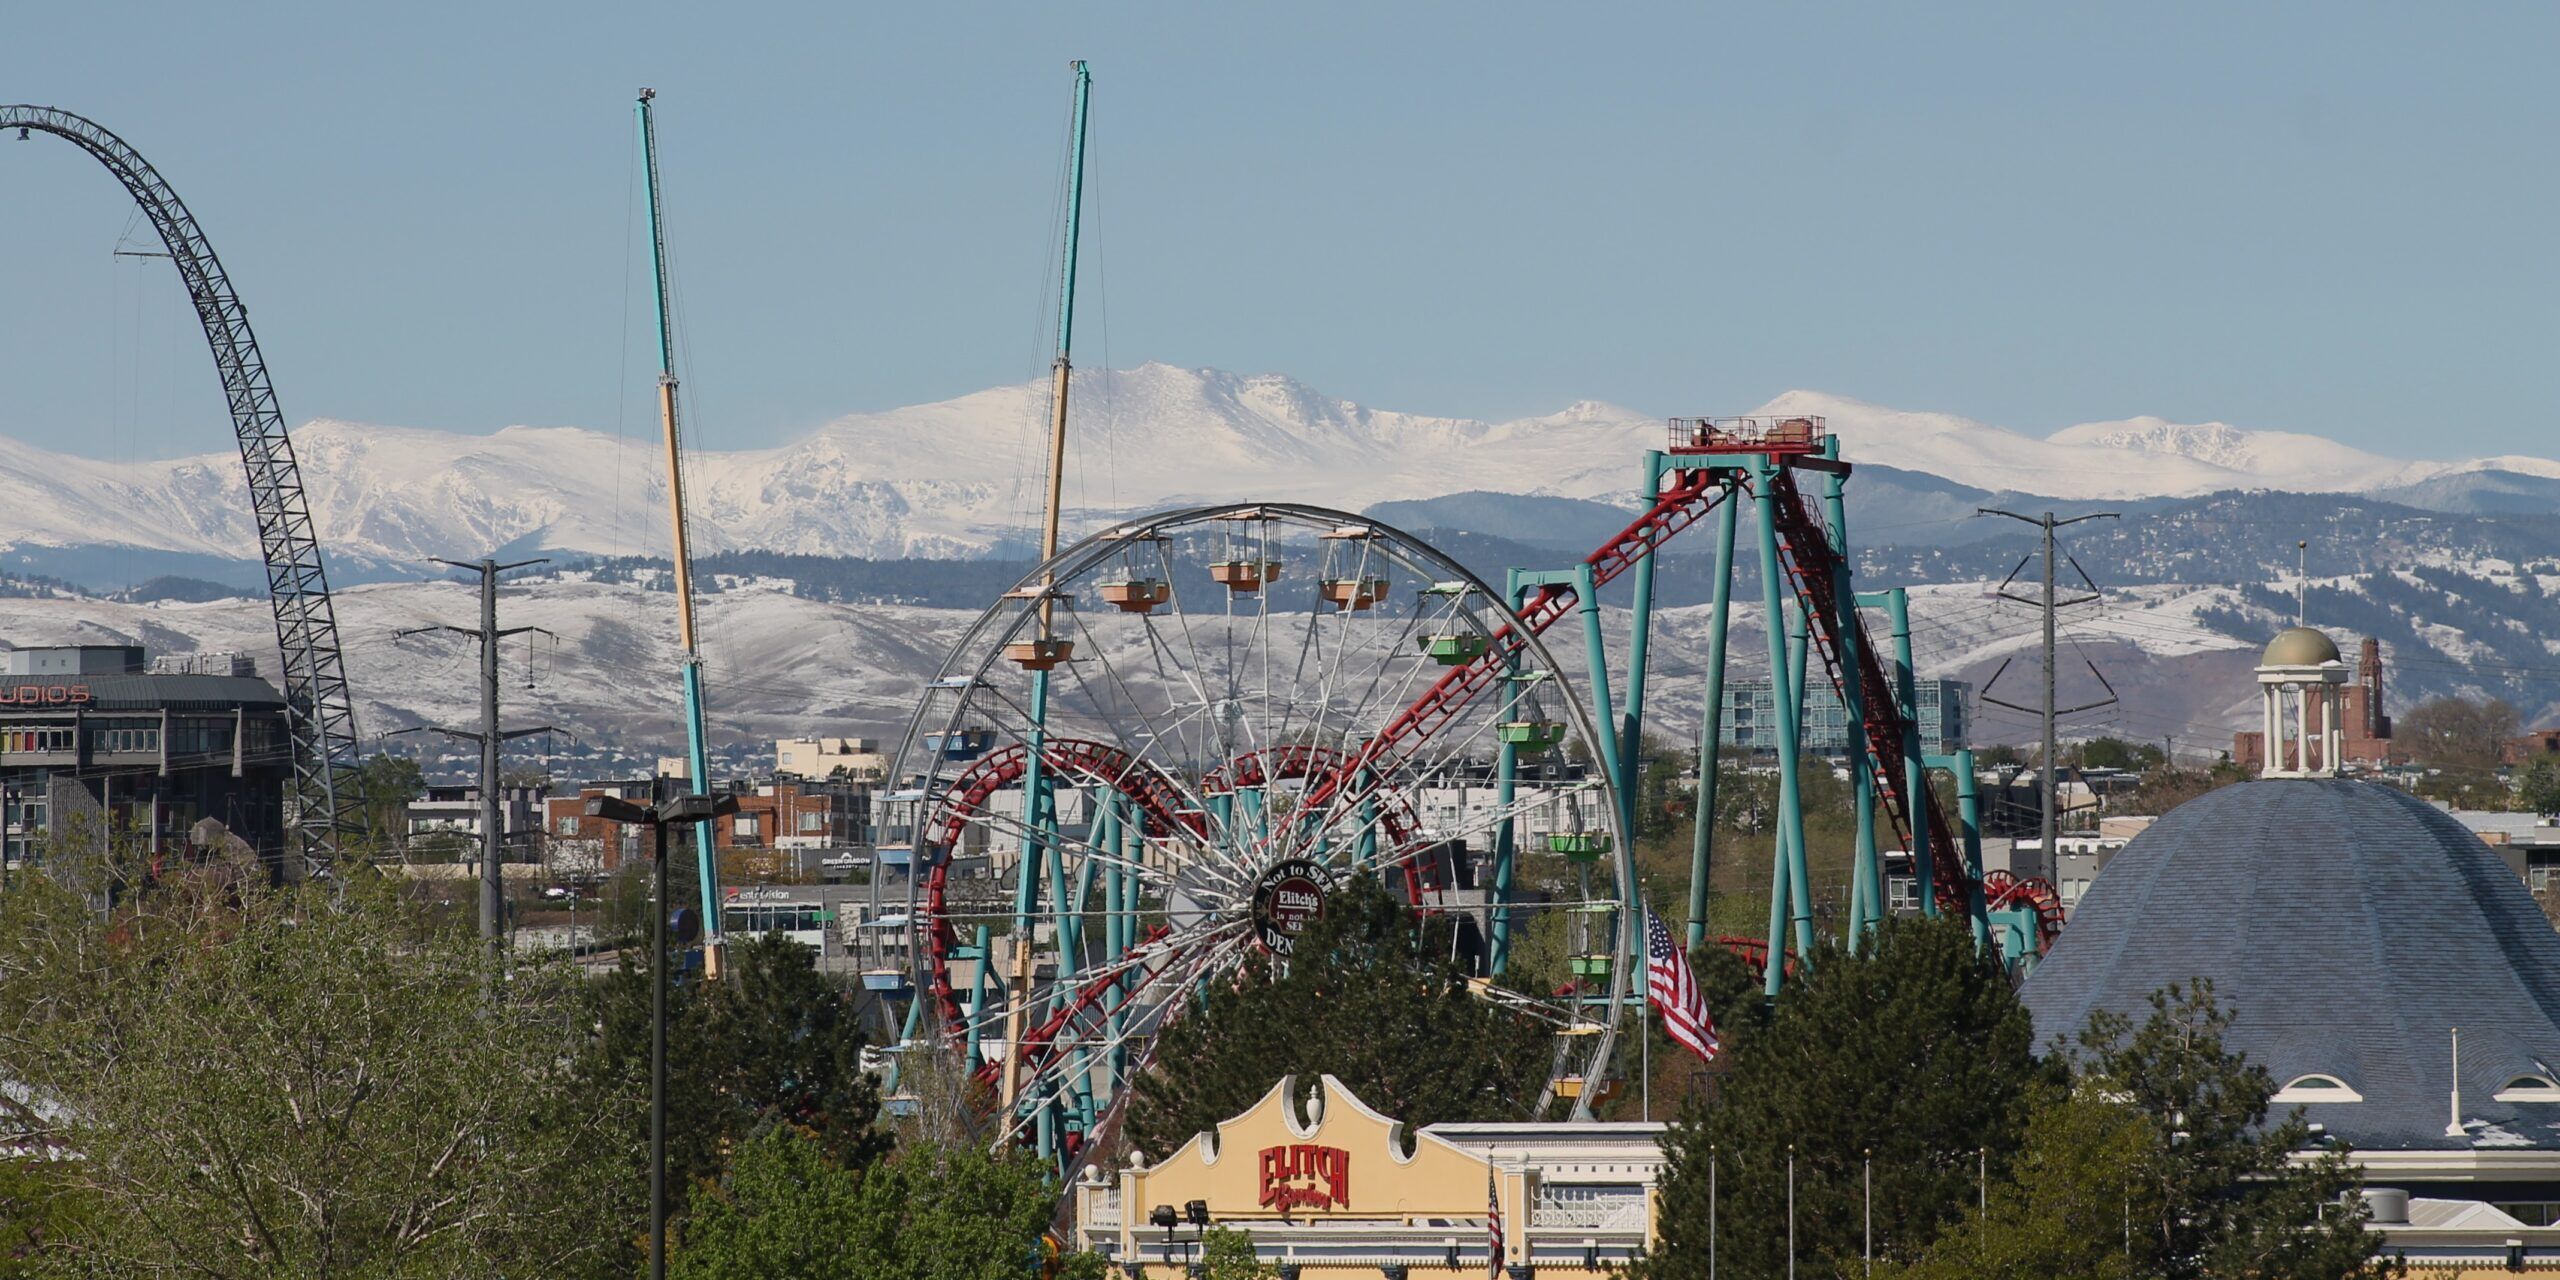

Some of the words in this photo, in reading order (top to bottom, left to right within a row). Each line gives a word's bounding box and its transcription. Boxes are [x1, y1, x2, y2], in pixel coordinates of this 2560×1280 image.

[1262, 869, 1286, 892] Not
[1289, 865, 1304, 876] to
[1306, 865, 1334, 898] SEE
[1279, 891, 1317, 907] Elitch's
[1288, 913, 1304, 921] not
[1258, 1144, 1350, 1211] ELITCH
